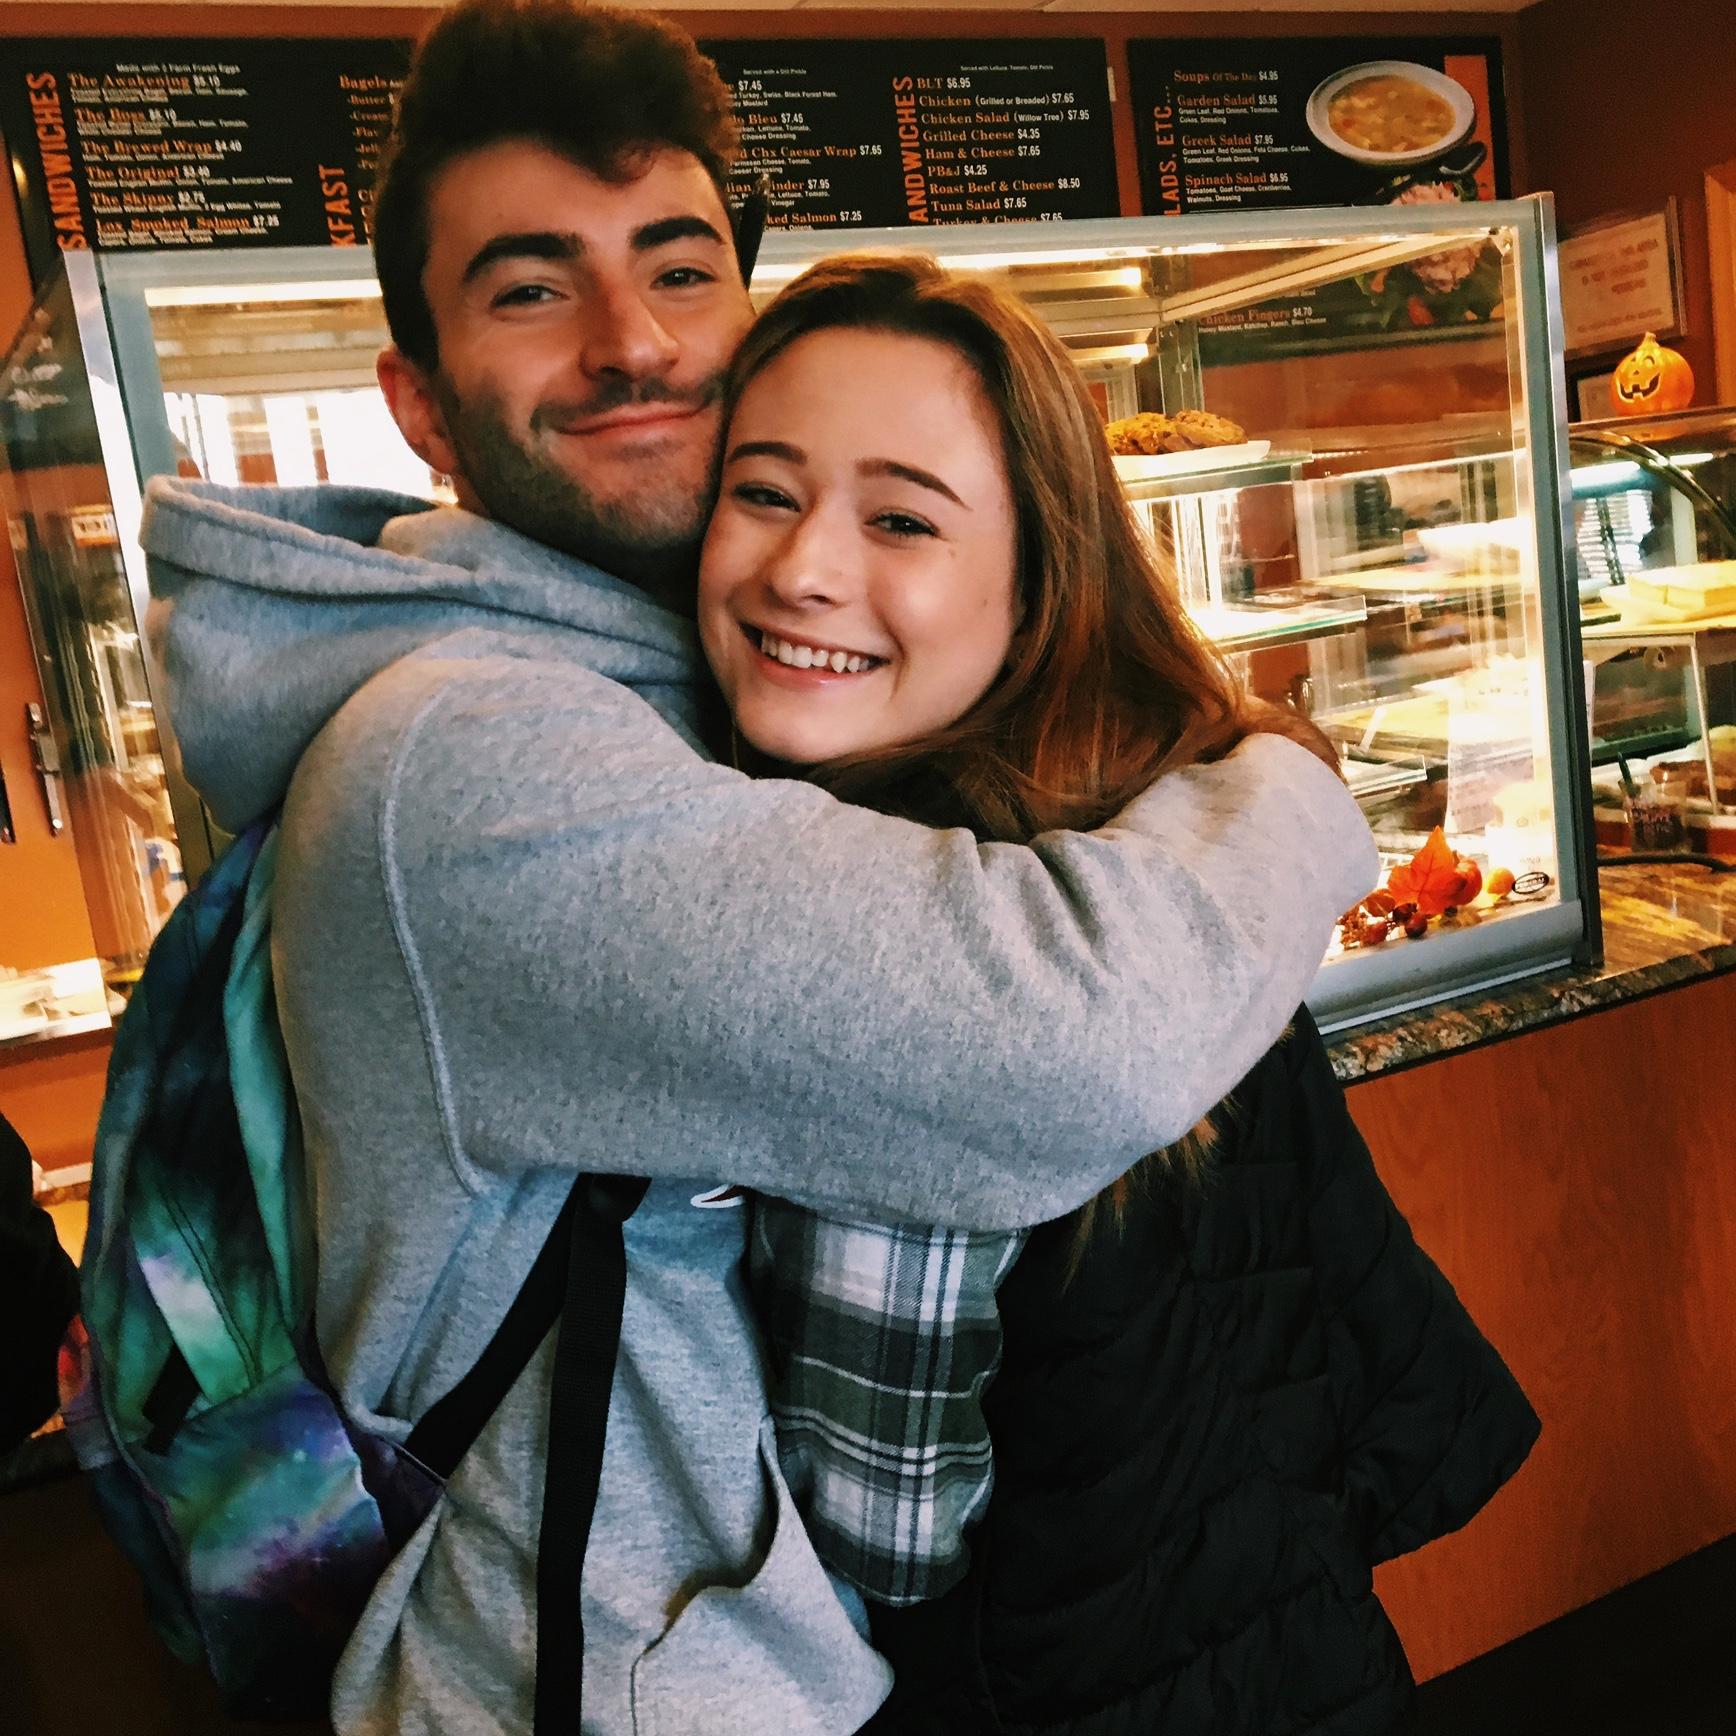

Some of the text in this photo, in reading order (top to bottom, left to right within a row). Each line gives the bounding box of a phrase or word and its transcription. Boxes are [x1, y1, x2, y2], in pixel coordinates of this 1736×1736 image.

[67, 72, 98, 87] The
[103, 73, 190, 89] Awakening
[340, 74, 387, 91] Bagels
[917, 77, 971, 89] BLT $6.95
[1174, 70, 1210, 84] Soups
[1225, 72, 1239, 81] The
[1258, 71, 1278, 81] $4.95
[738, 80, 762, 91] $7.45
[919, 96, 971, 107] Chicken
[1051, 93, 1074, 104] $7.65
[1177, 93, 1278, 106] Garden Salad $5.95
[74, 108, 105, 123] The
[749, 113, 777, 124] Bleu
[781, 112, 804, 124] $7.45
[921, 113, 972, 124] Chicken
[975, 112, 1010, 123] Salad
[1067, 109, 1090, 121] $7.95
[922, 128, 1040, 142] Grilled Cheese $4.35
[1182, 134, 1274, 146] Greek Salad $7.95
[81, 140, 110, 154] The
[752, 147, 776, 158] Chx
[781, 146, 821, 157] Caesar
[824, 146, 857, 159] Wrap
[860, 145, 882, 156] $7.65
[893, 76, 929, 223] ANDWICHES
[926, 145, 1040, 160] Ham & Cheese $7.65
[27, 71, 88, 249] SANDWICHES
[85, 166, 114, 178] The
[928, 164, 987, 177] PB&J $4.25
[772, 180, 805, 191] inder
[808, 179, 830, 190] $7.95
[930, 178, 1080, 195] Roast Beef & Cheese $8.50
[1160, 153, 1182, 217] LADS,
[1185, 174, 1233, 189] Spinach
[1236, 173, 1267, 184] Salad
[90, 192, 120, 205] The
[318, 163, 357, 247] KFAST
[931, 197, 1027, 212] Tuna Salad $7.65
[767, 211, 862, 225] ked Salmon $7.25
[994, 215, 1038, 224] Cheese
[1201, 306, 1312, 326] hicken Fingers $4.70
